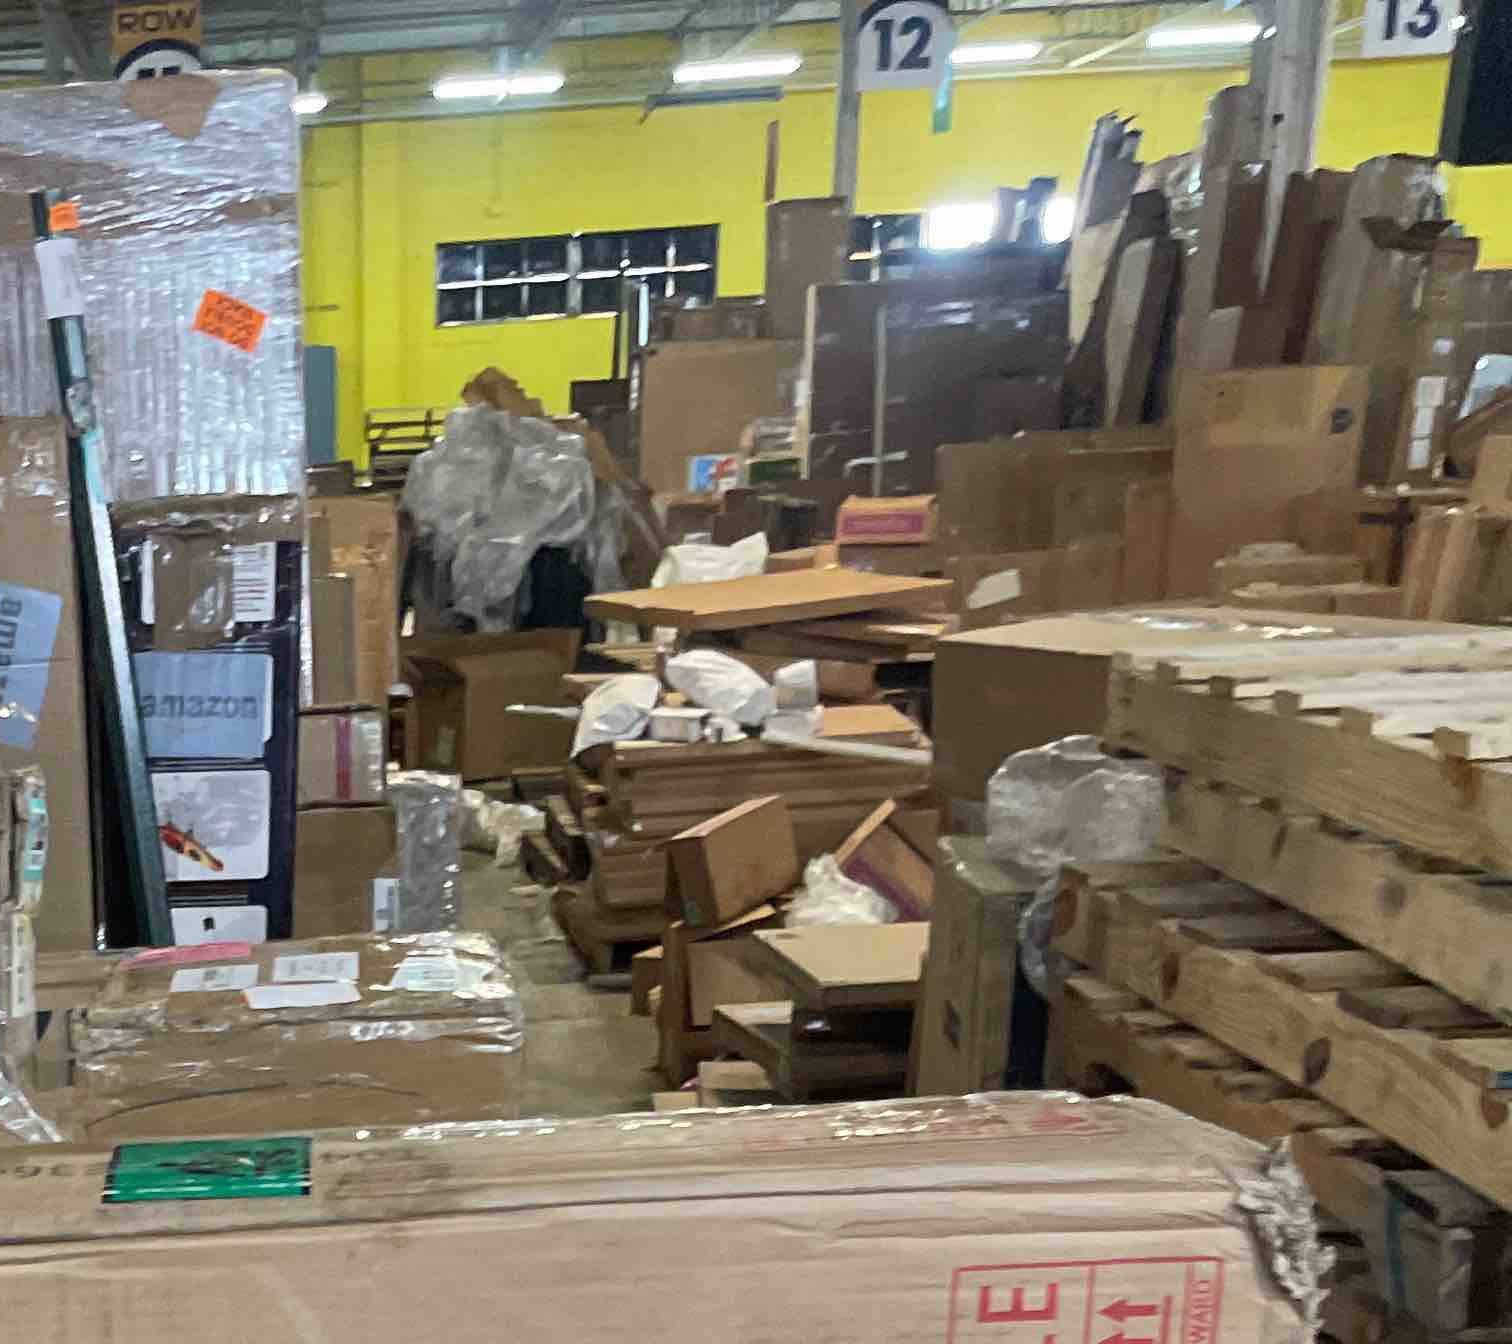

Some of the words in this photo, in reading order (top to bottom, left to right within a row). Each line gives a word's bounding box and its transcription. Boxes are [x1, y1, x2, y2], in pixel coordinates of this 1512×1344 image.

[117, 6, 197, 34] ROW
[1383, 0, 1439, 40] 13
[873, 16, 933, 71] 12
[142, 693, 258, 719] amazon
